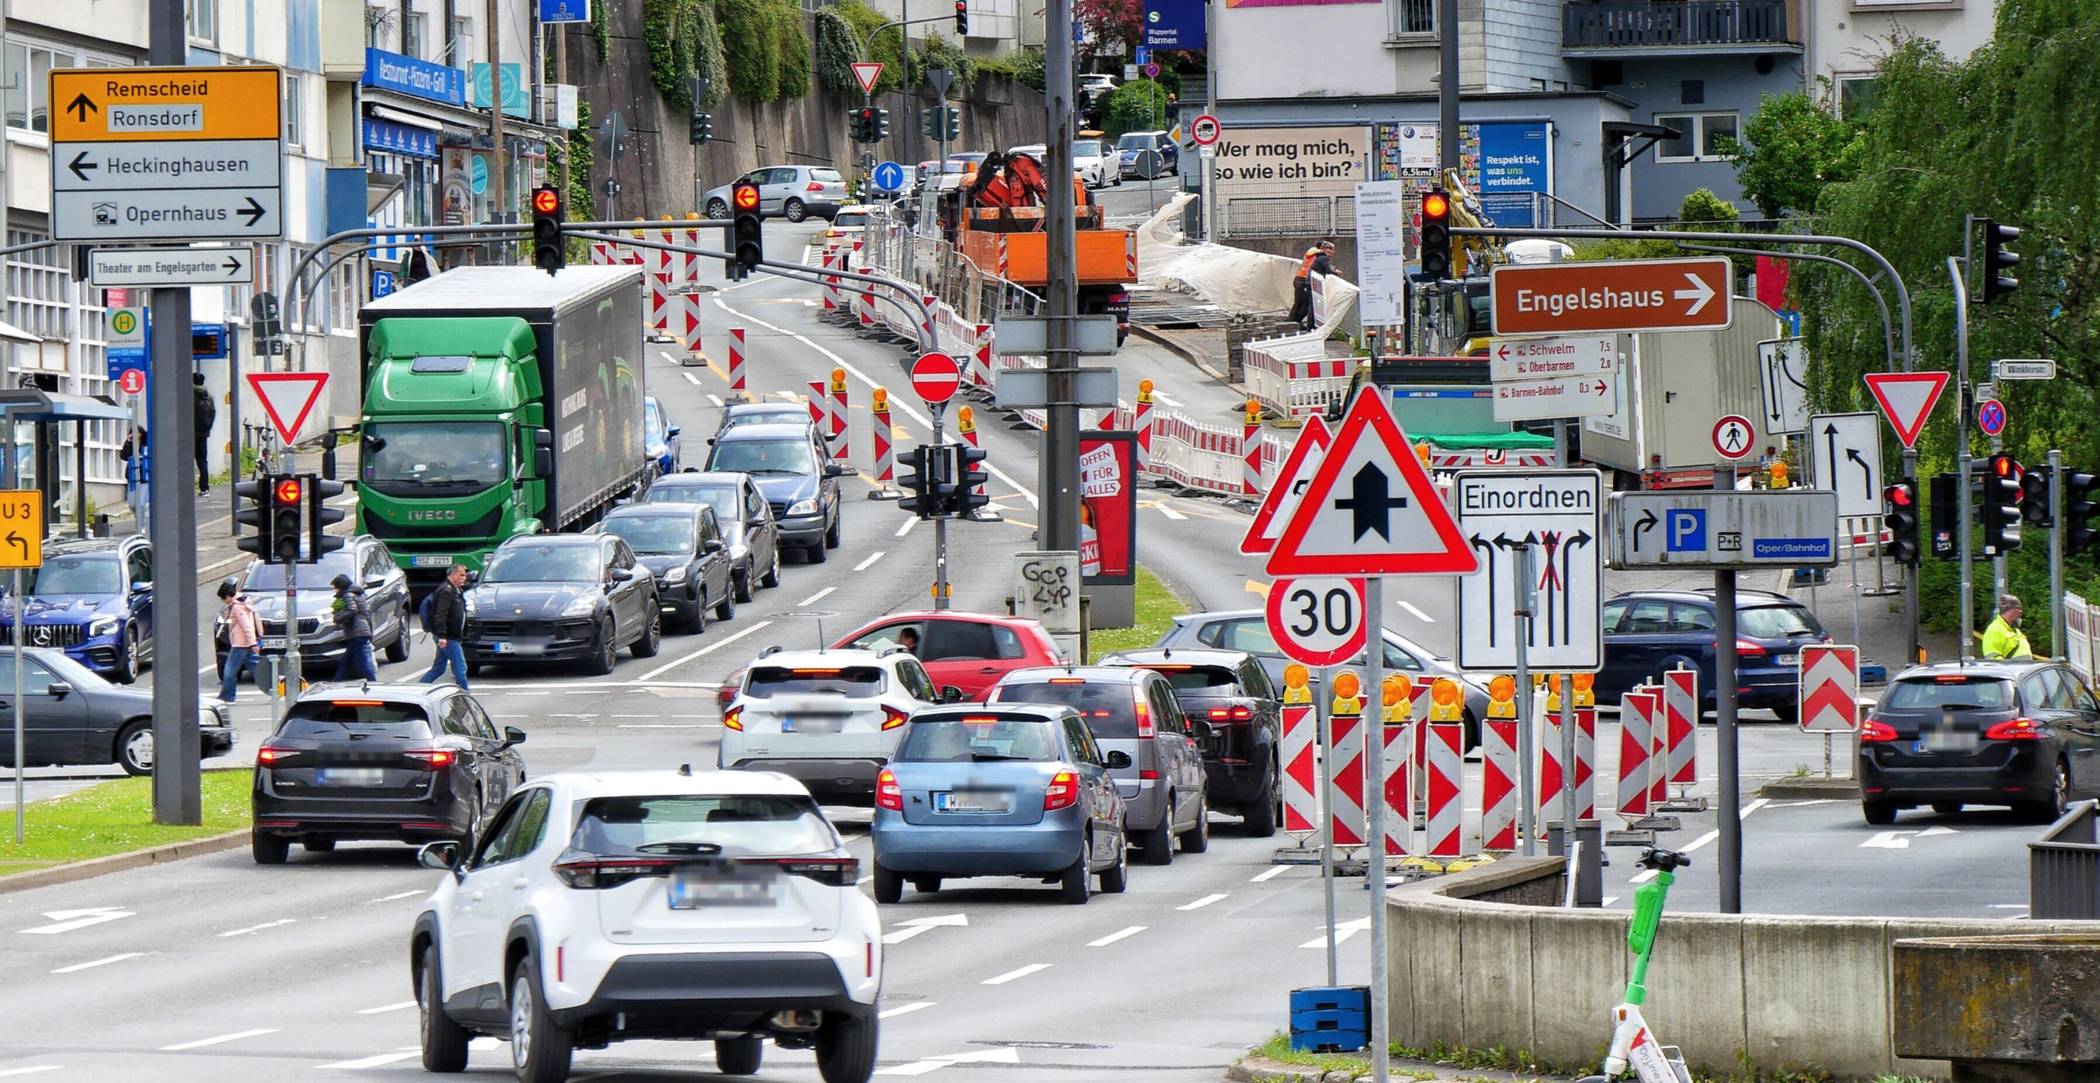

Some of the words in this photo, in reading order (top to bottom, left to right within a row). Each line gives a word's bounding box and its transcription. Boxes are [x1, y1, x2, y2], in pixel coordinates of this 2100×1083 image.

[1148, 28, 1177, 36] Wuppertal
[1148, 36, 1177, 45] Barmen
[106, 79, 208, 97] Remscheid
[113, 109, 198, 127] Ronsdorf
[1215, 141, 1250, 157] Wer
[1256, 143, 1298, 160] mag
[1304, 138, 1355, 156] mich,
[107, 156, 249, 177] Heckinghausen
[1486, 155, 1523, 167] Respekt
[1525, 154, 1540, 166] ist,
[1215, 167, 1234, 180] so
[1240, 163, 1274, 179] wie
[1279, 162, 1307, 178] ich
[1487, 168, 1505, 176] was
[1507, 167, 1524, 175] uns
[1487, 176, 1534, 187] verbindet.
[126, 204, 228, 225] Opernhaus
[98, 262, 133, 275] Theater
[137, 264, 152, 274] am
[155, 260, 217, 277] Engelsgarten
[378, 274, 389, 295] P
[1517, 287, 1664, 316] Engelshaus
[119, 315, 130, 330] H
[1529, 343, 1575, 356] Schwelm
[1600, 340, 1611, 352] 7,5
[1529, 361, 1575, 373] Oberbarmen
[1600, 357, 1611, 369] 2,0
[1511, 385, 1564, 398] Barmen-Bahnhof
[1081, 450, 1111, 467] OFFEN
[1093, 467, 1114, 480] FÜR
[1087, 484, 1117, 495] ALLES
[1465, 483, 1591, 509] Einordnen
[3, 504, 15, 519] U
[21, 503, 31, 519] 3
[407, 510, 457, 521] IVECO
[1674, 513, 1698, 547] P
[1717, 535, 1743, 549] P+R
[1756, 543, 1828, 553] Oper/Bahnhof
[1022, 562, 1067, 584] GCP
[1291, 588, 1352, 637] 30
